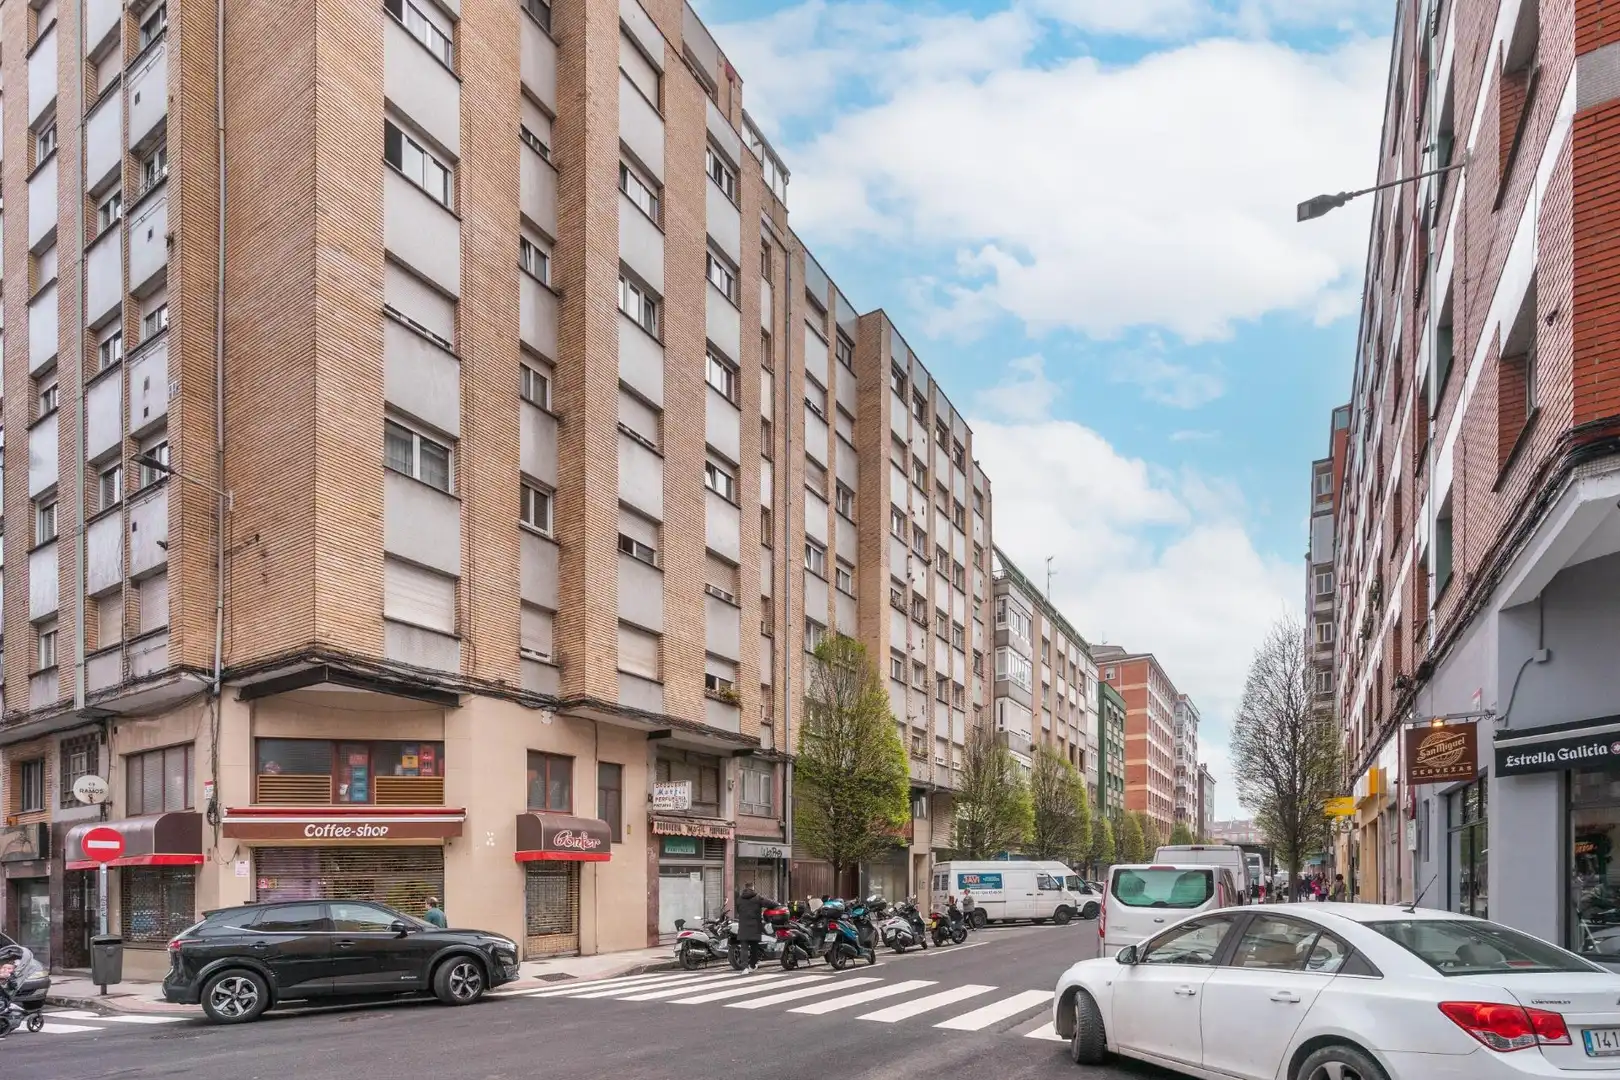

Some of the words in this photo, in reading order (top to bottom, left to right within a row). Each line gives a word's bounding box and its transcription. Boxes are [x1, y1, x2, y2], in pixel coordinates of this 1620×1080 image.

[1505, 751, 1556, 768] Estrella
[1557, 743, 1609, 761] Galicia
[1412, 766, 1472, 775] CERVEZAS
[304, 823, 389, 838] Coffee-shop
